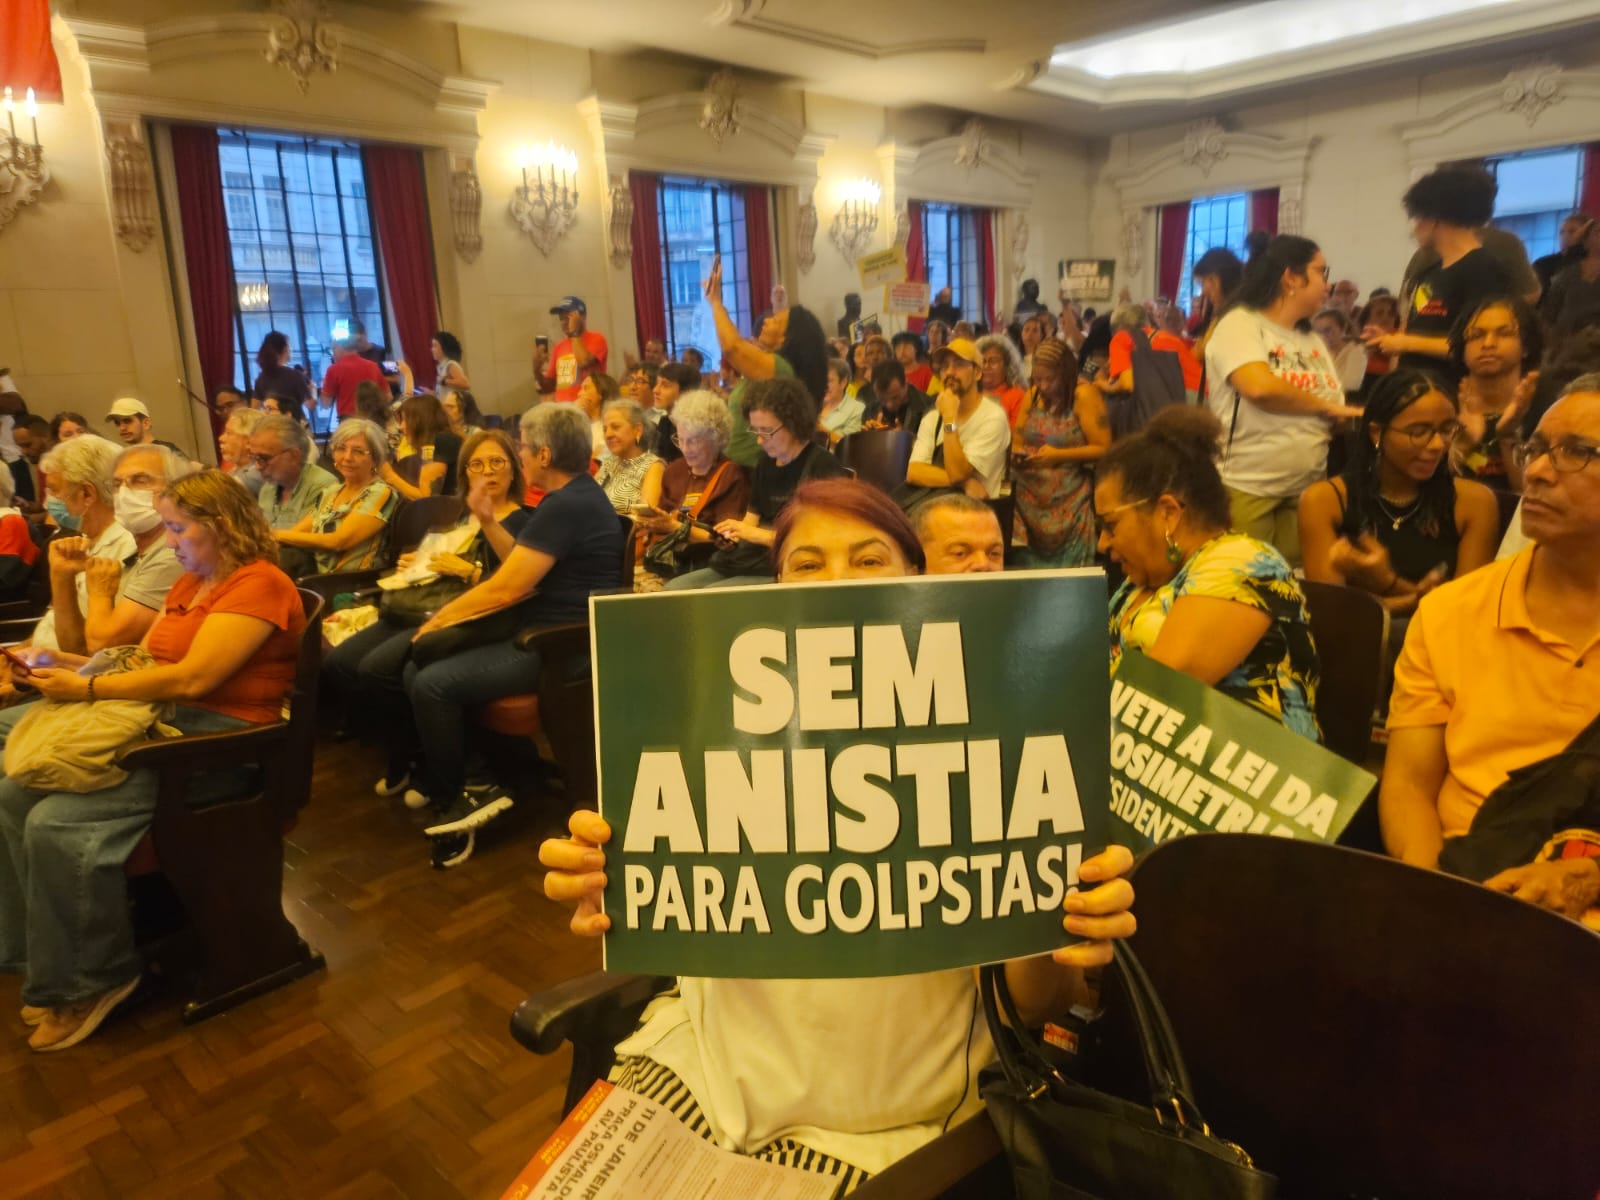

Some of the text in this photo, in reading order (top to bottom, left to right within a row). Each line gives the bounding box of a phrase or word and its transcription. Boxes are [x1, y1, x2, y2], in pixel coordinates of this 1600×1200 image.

[729, 620, 970, 736] SEM
[622, 734, 1085, 854] ANISTIA
[1110, 679, 1338, 840] VETE A LEI DA
[1110, 732, 1295, 839] OSIMETRI
[1109, 776, 1198, 845] SIDENT
[624, 843, 1084, 935] PARA GOLPSTAS!
[594, 1108, 615, 1128] AV.
[602, 1099, 637, 1140] PRAÇA
[625, 1121, 648, 1144] DE
[641, 1107, 656, 1120] 11
[546, 1130, 599, 1192] PAULISTA
